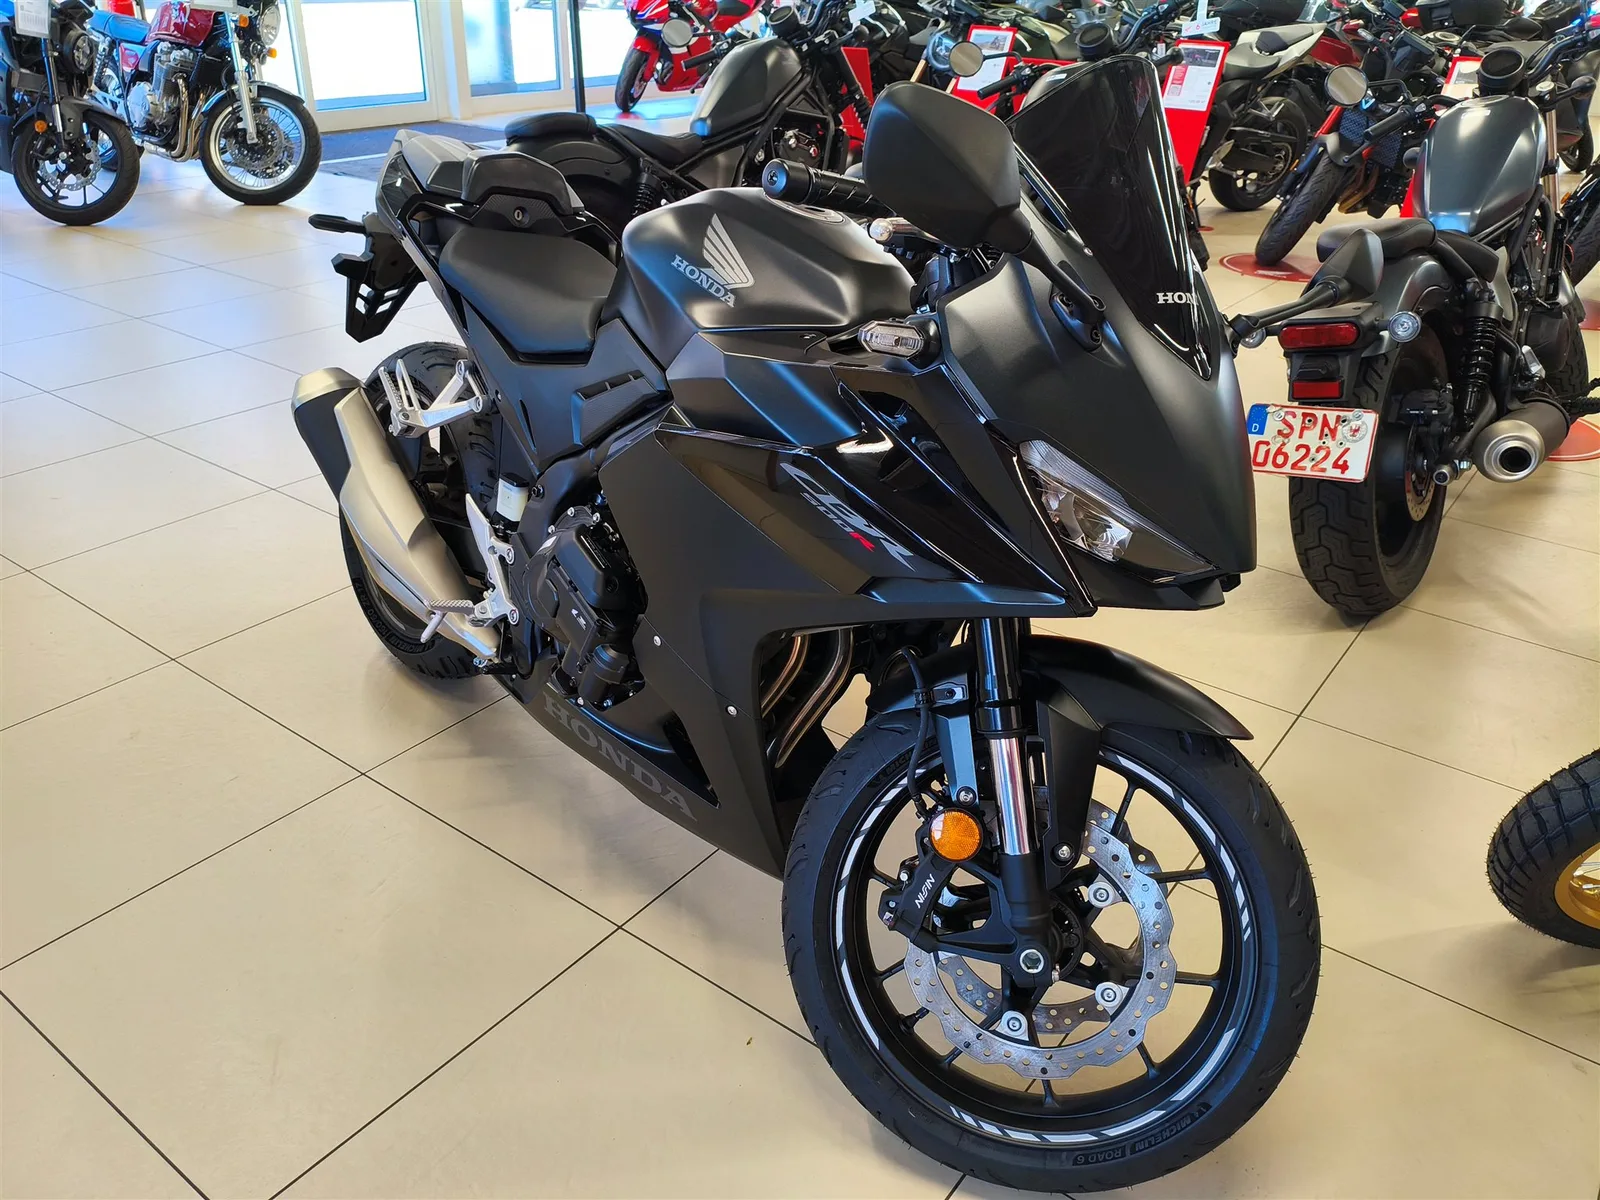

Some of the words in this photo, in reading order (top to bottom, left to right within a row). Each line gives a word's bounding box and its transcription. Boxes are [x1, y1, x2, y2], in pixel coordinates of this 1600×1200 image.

[671, 254, 736, 308] HONDA
[1251, 423, 1260, 433] D
[1277, 410, 1343, 442] SPN
[1252, 440, 1351, 475] 06224
[543, 691, 698, 823] HONDA
[1135, 1116, 1192, 1151] MICHELIN
[1076, 1154, 1085, 1165] 6
[1088, 1149, 1122, 1164] ROAD
